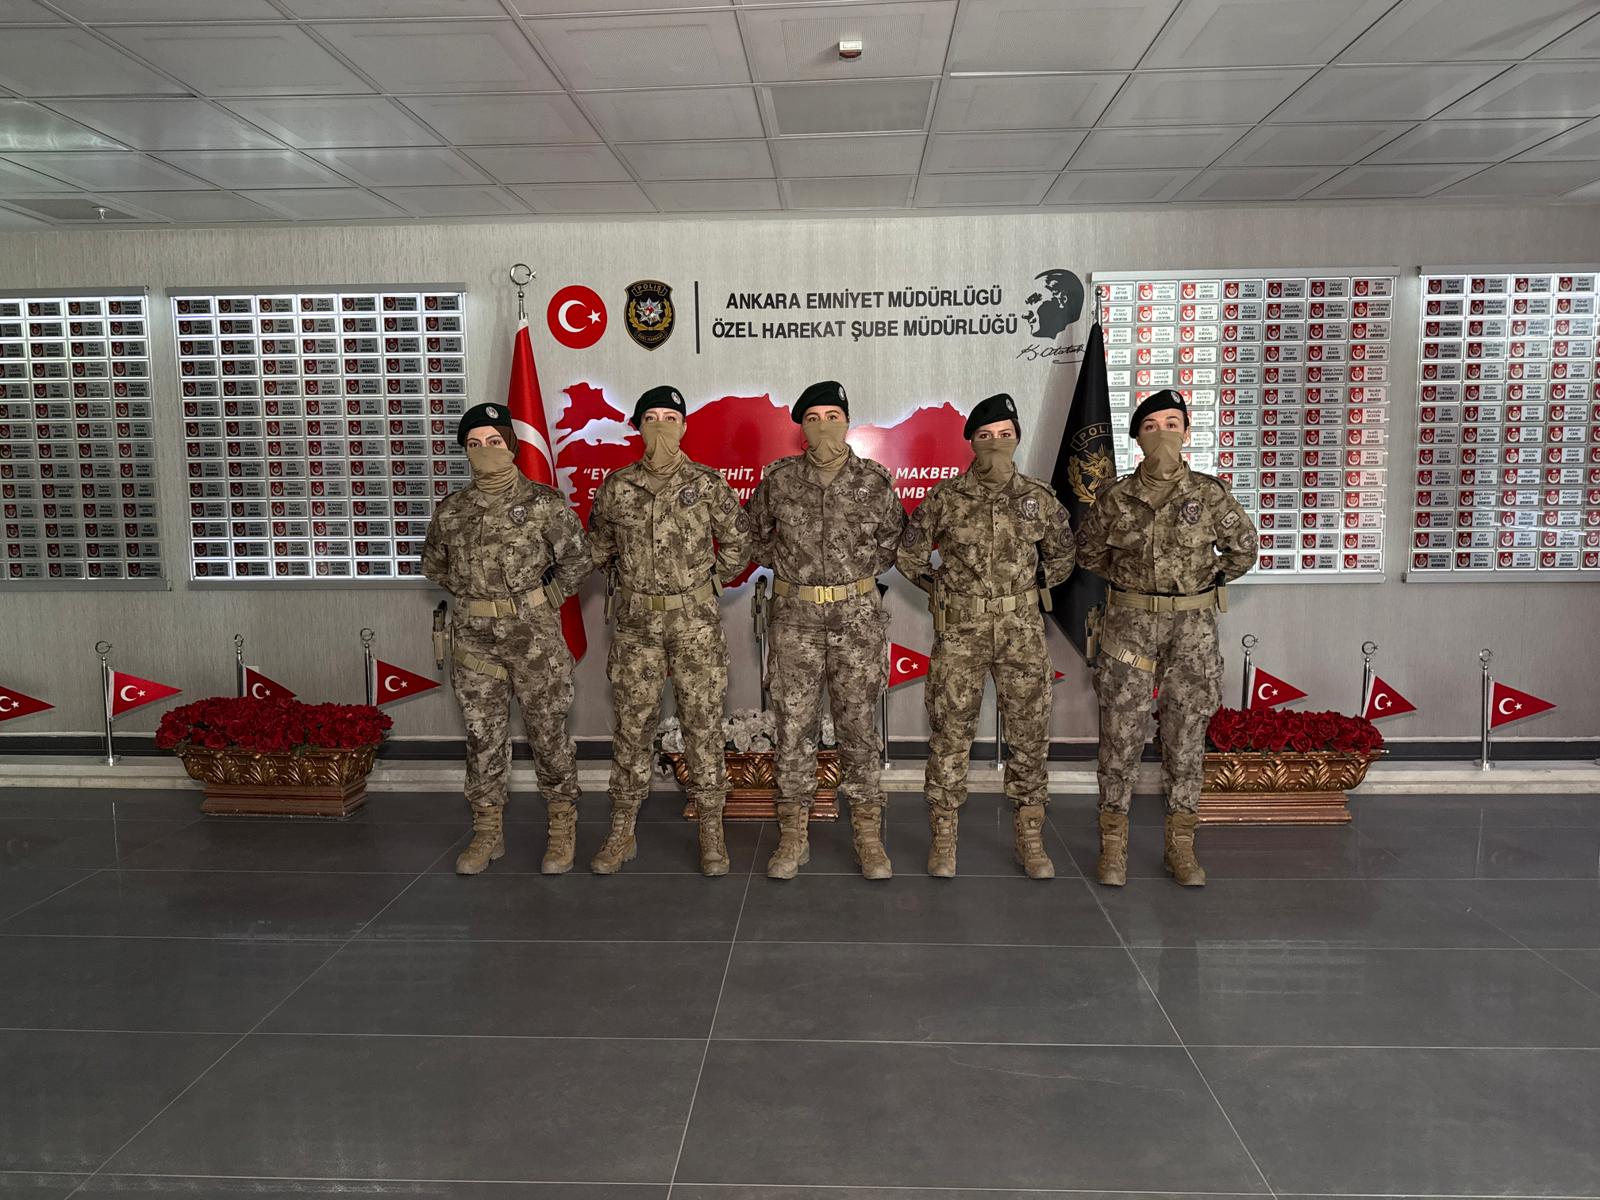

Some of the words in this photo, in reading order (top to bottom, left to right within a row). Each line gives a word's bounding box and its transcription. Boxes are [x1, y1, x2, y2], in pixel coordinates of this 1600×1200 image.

[726, 292, 802, 310] ANKARA
[806, 287, 884, 310] EMNİYET
[712, 317, 759, 339] ÖZEL
[762, 320, 847, 339] HAREKAT
[851, 319, 899, 342] ŞUBE
[903, 313, 1018, 337] MÜDÜRLÜĞÜ
[583, 468, 611, 480] “EY
[895, 466, 960, 479] MAKBER
